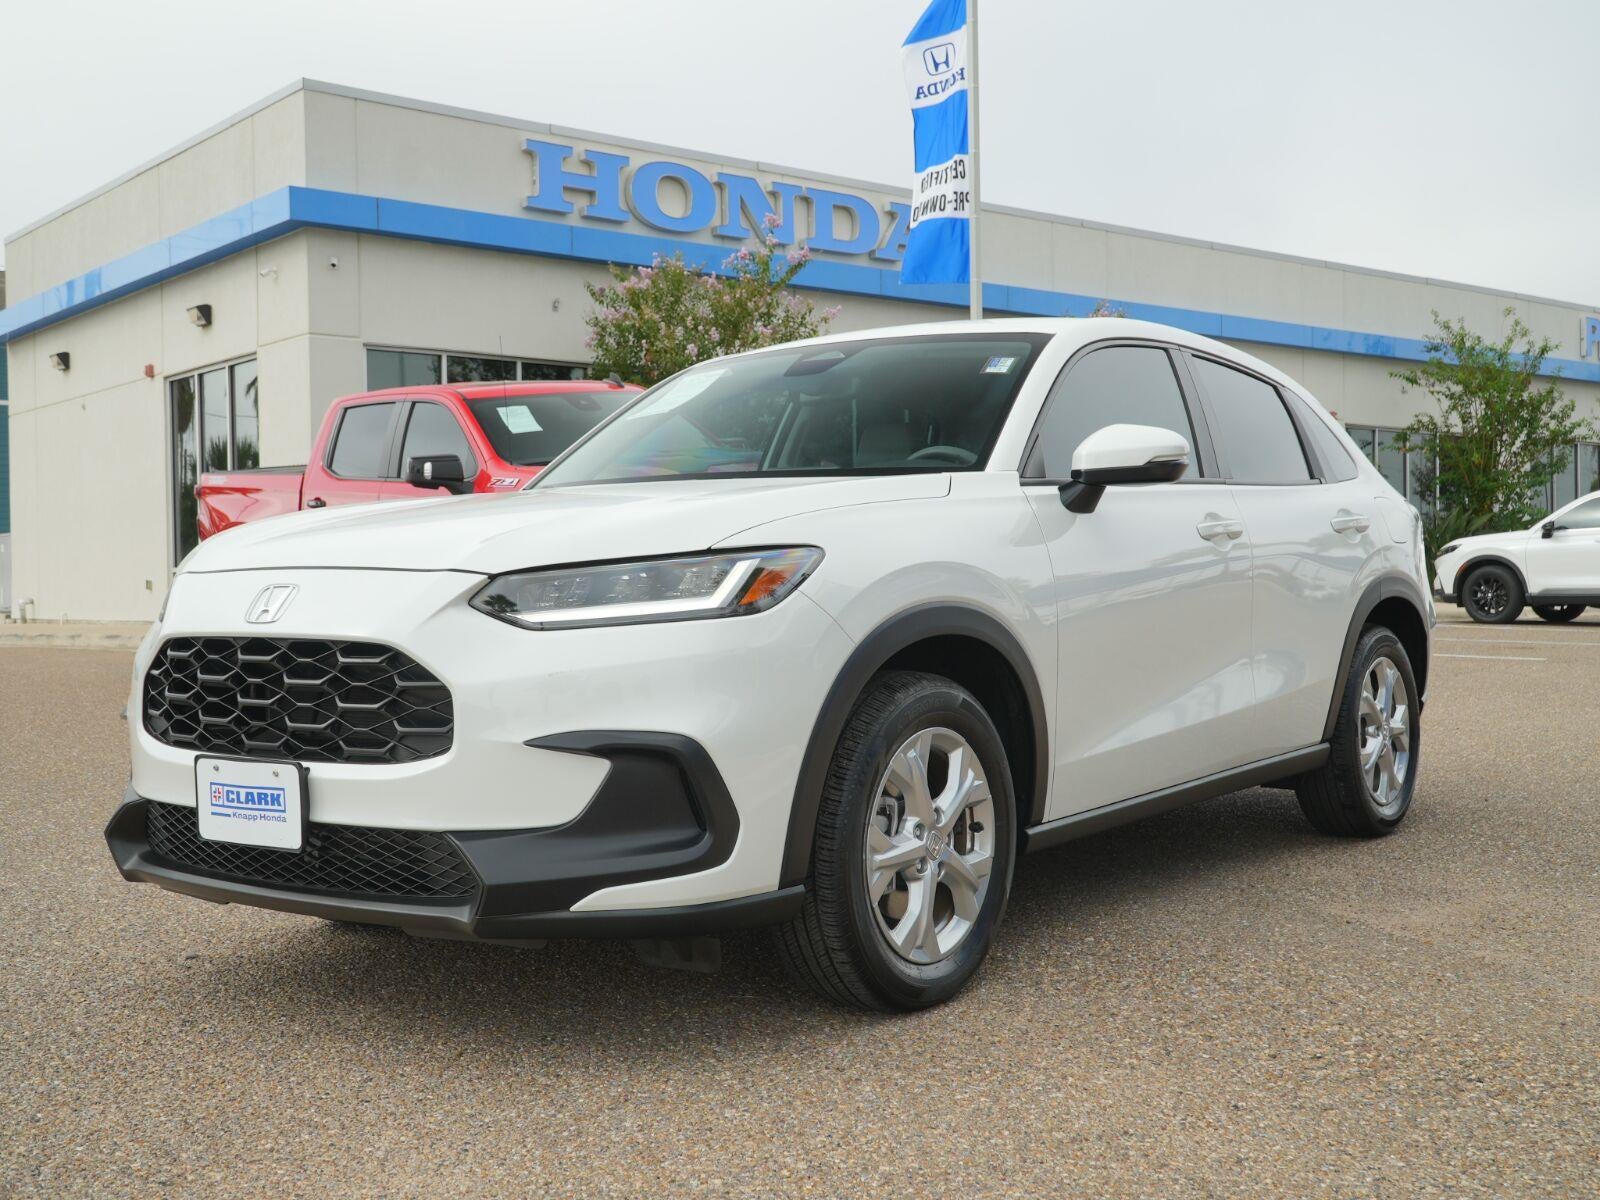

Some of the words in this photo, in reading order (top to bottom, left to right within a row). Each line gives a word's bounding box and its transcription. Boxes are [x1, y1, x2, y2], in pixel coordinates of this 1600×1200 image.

[225, 789, 282, 807] CLARK
[232, 811, 258, 821] Knapp
[259, 813, 287, 823] Honda
